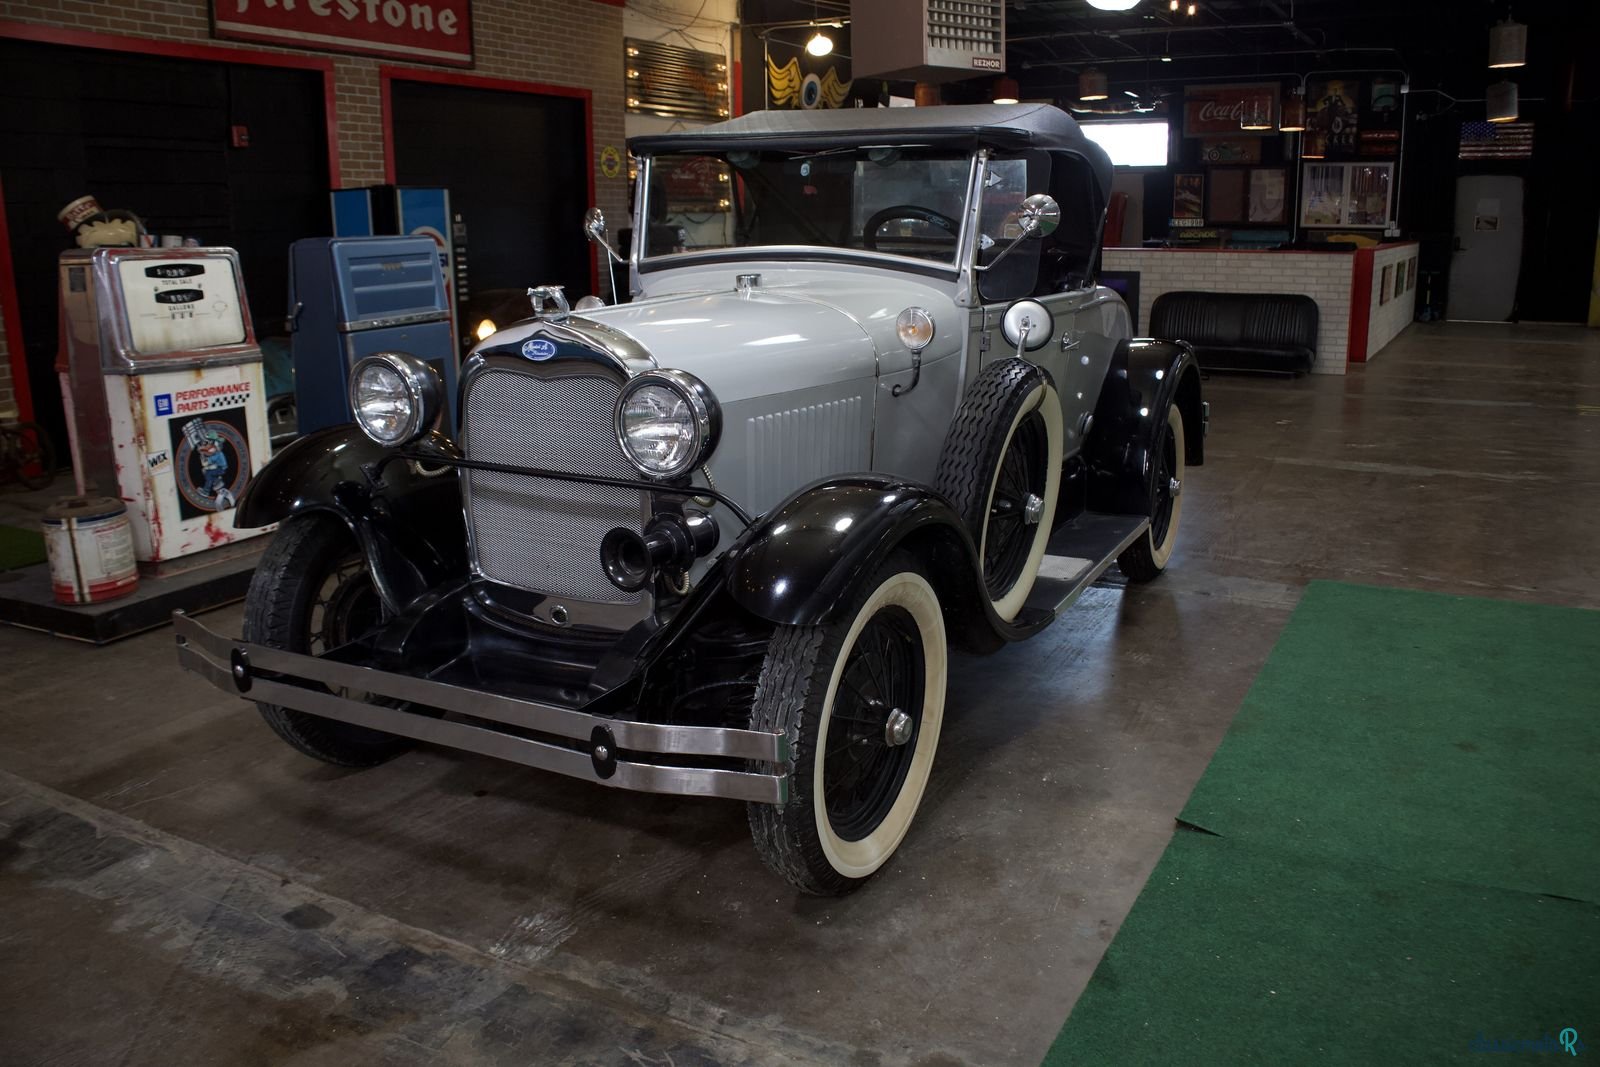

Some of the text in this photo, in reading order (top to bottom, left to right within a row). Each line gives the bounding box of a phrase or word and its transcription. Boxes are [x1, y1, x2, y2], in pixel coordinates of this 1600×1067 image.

[973, 59, 1000, 68] REZNOR
[176, 382, 250, 401] PERFORMANCE
[177, 400, 208, 414] PARTS
